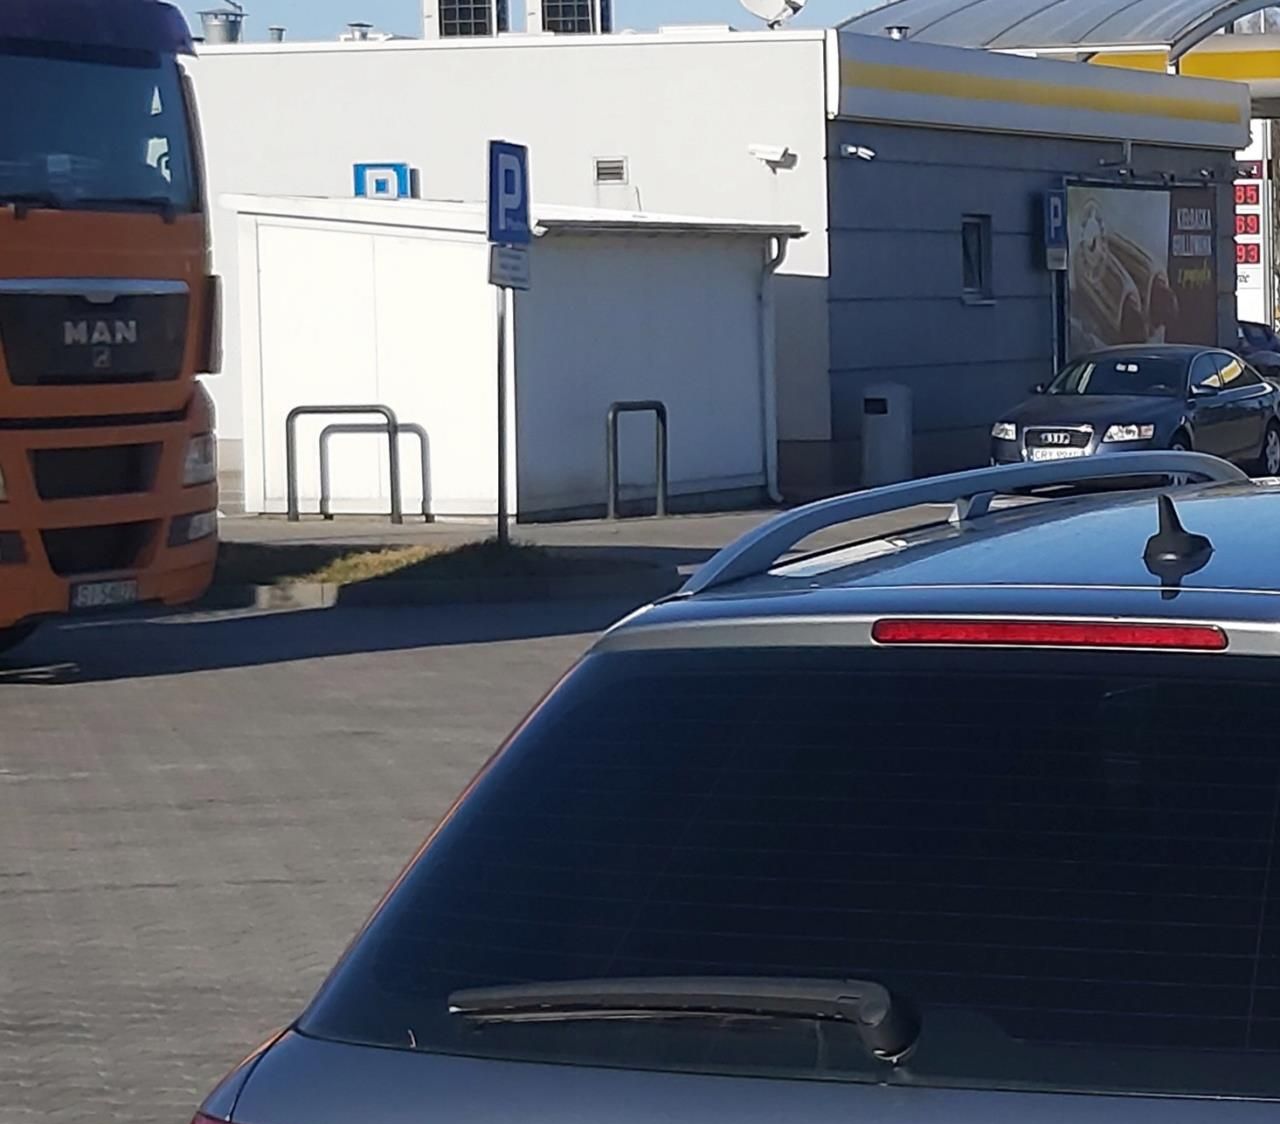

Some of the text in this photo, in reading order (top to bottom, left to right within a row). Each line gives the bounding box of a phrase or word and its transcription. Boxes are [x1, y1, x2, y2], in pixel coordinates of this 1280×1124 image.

[499, 153, 521, 230] P
[1050, 196, 1063, 239] P
[64, 320, 137, 345] MAN
